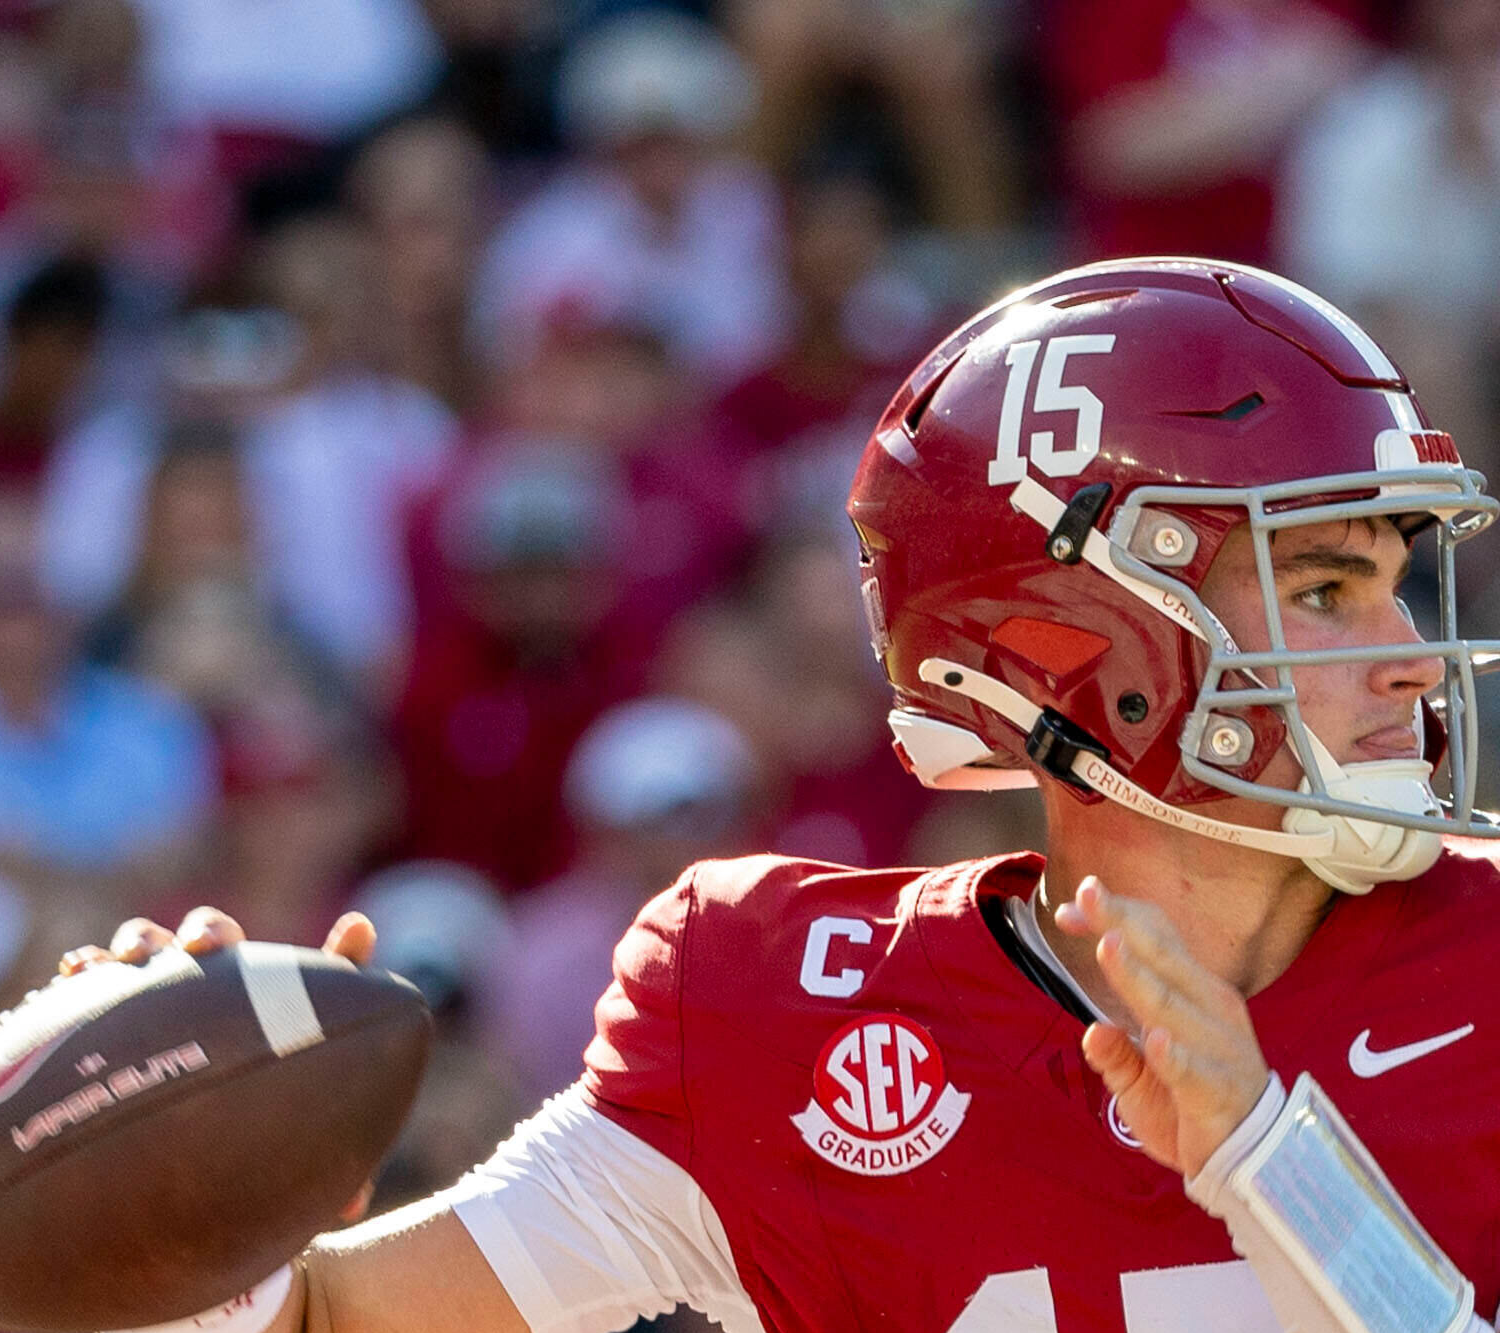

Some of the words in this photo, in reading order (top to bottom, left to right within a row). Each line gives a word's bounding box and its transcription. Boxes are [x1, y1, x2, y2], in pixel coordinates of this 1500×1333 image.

[987, 334, 1117, 487] 15
[1086, 760, 1184, 824] CRIMSON
[1194, 820, 1242, 843] TIDE
[799, 915, 874, 998] C
[826, 1022, 933, 1133] SEC
[818, 1117, 949, 1170] GRADUATE
